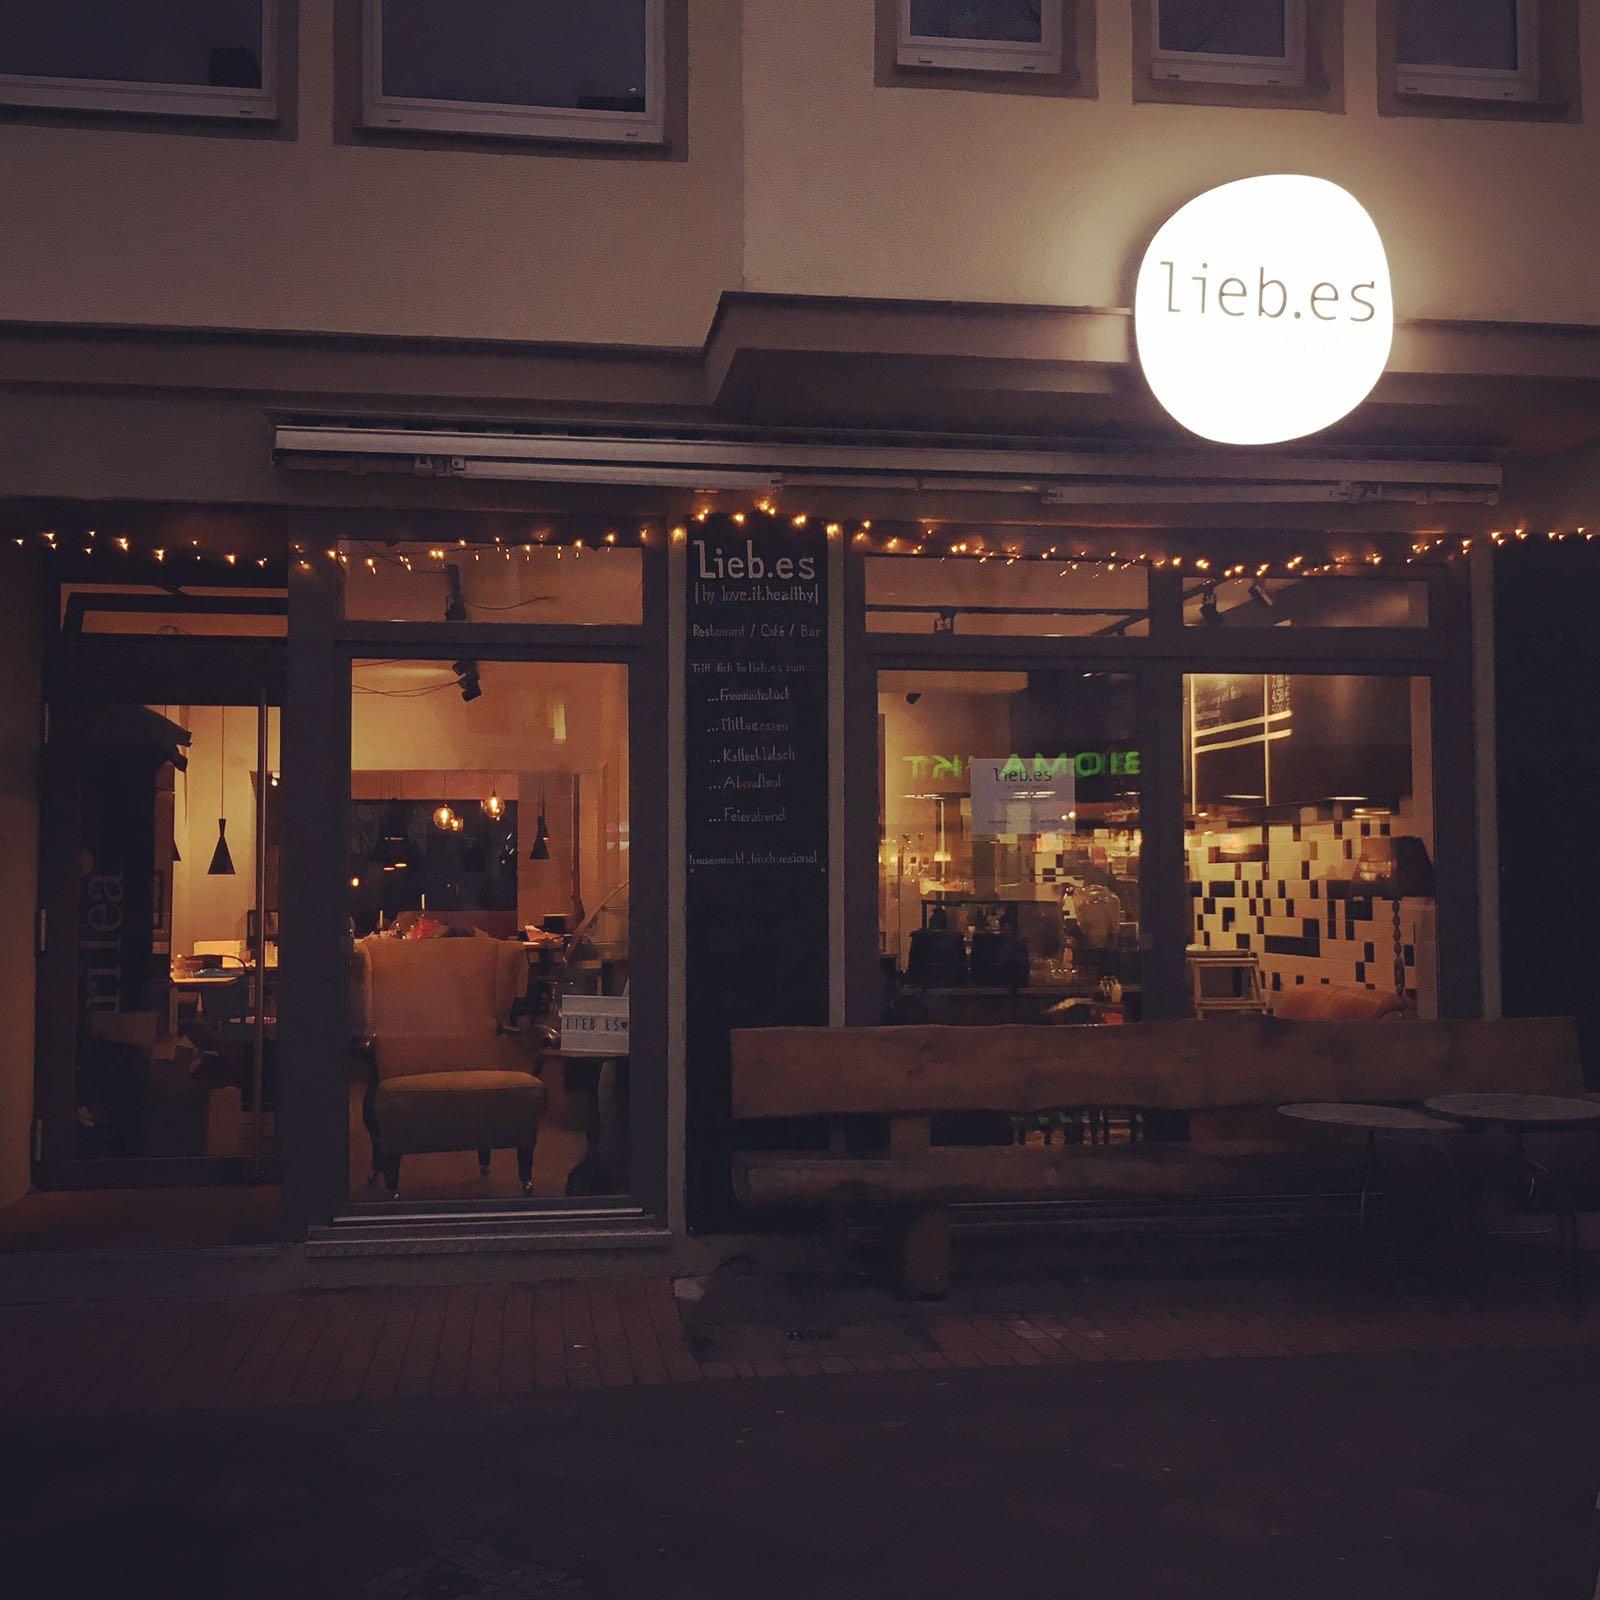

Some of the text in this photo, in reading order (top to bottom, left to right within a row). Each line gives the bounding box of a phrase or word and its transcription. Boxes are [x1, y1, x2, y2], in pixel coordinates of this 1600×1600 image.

[1160, 261, 1375, 322] lieb.es
[693, 624, 745, 637] Restaurant
[761, 624, 785, 637] Café
[800, 624, 820, 637] Bar
